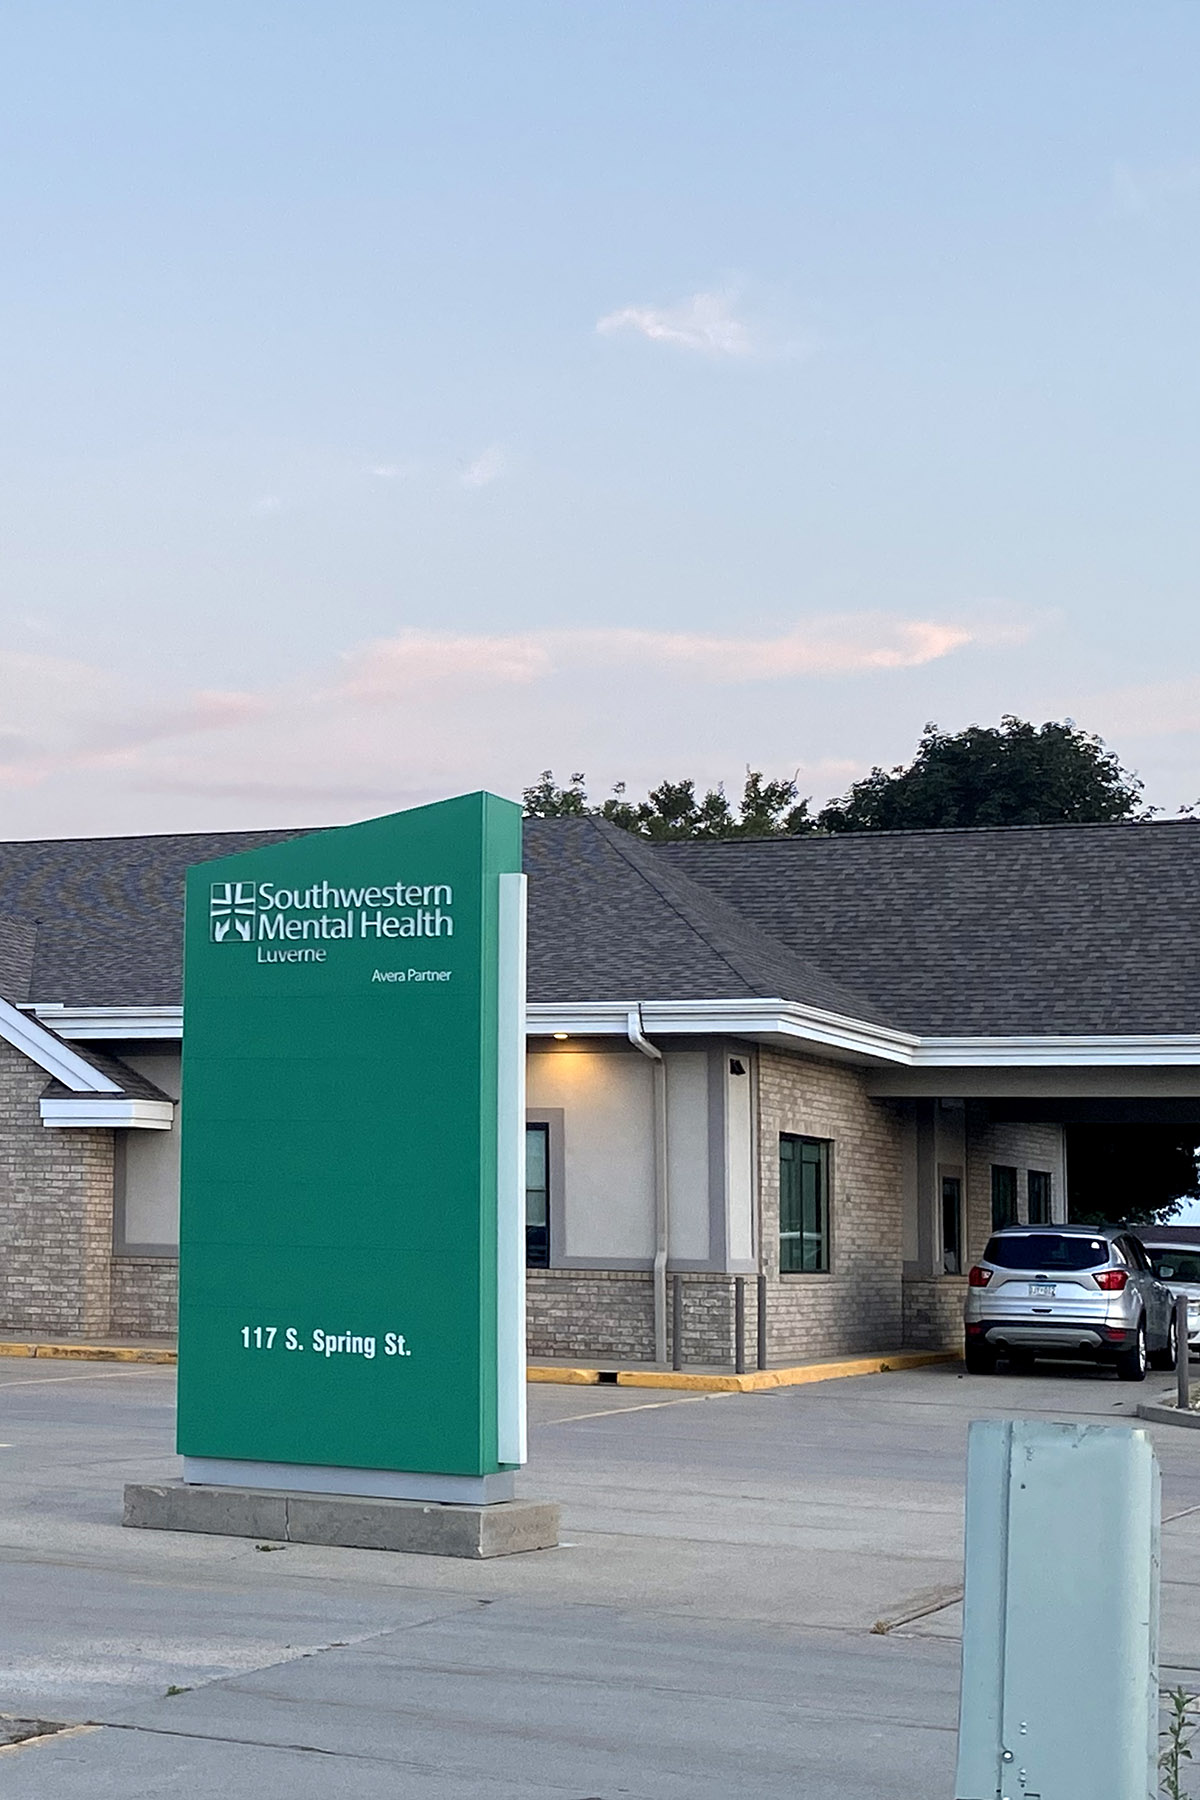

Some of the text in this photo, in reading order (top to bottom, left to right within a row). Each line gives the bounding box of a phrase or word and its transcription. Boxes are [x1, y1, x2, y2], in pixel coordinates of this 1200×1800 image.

[258, 880, 452, 910] Southwestern
[258, 907, 453, 941] Mental Health
[257, 946, 327, 963] Luverne
[371, 968, 452, 983] Avera Partner
[240, 1326, 412, 1359] 117 S. Spring St.
